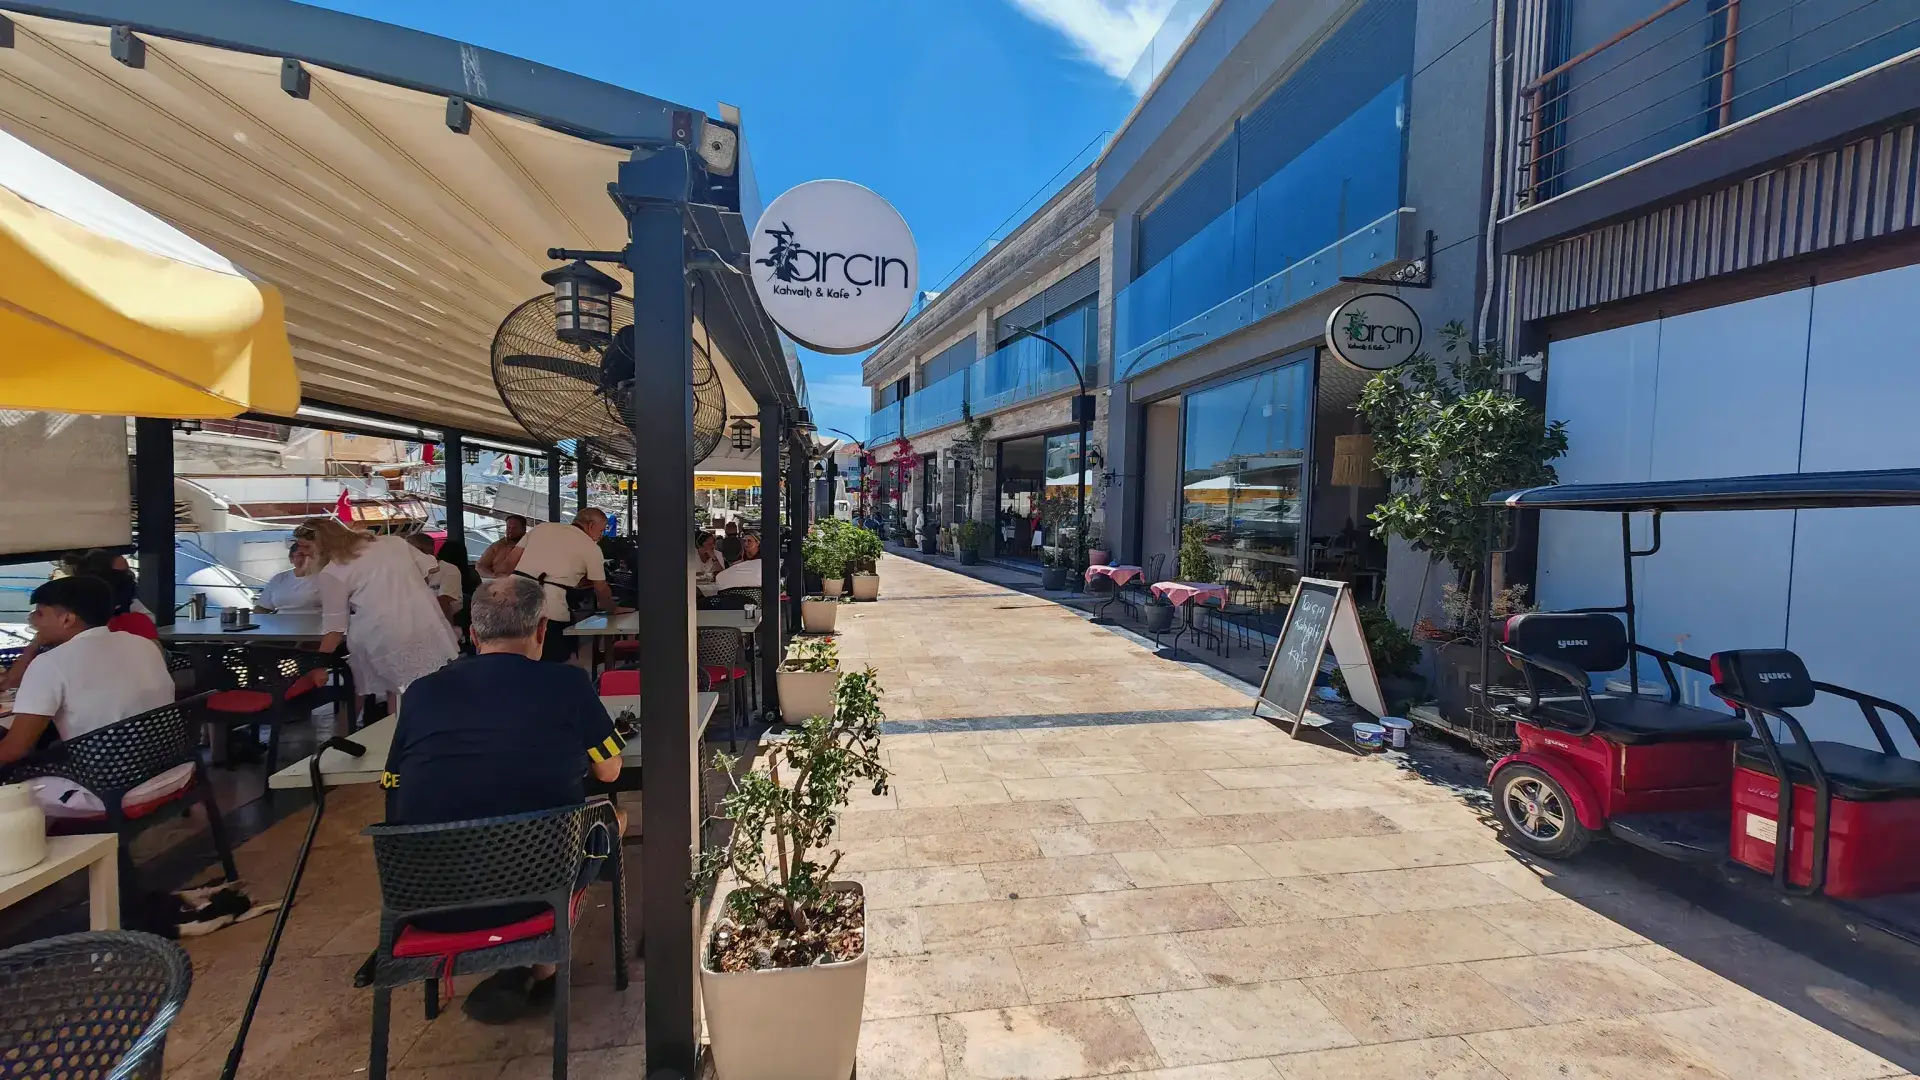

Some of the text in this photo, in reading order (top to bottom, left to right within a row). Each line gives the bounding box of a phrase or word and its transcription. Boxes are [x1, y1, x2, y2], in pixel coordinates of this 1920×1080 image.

[773, 285, 850, 299] Kahvaltı & Kafe
